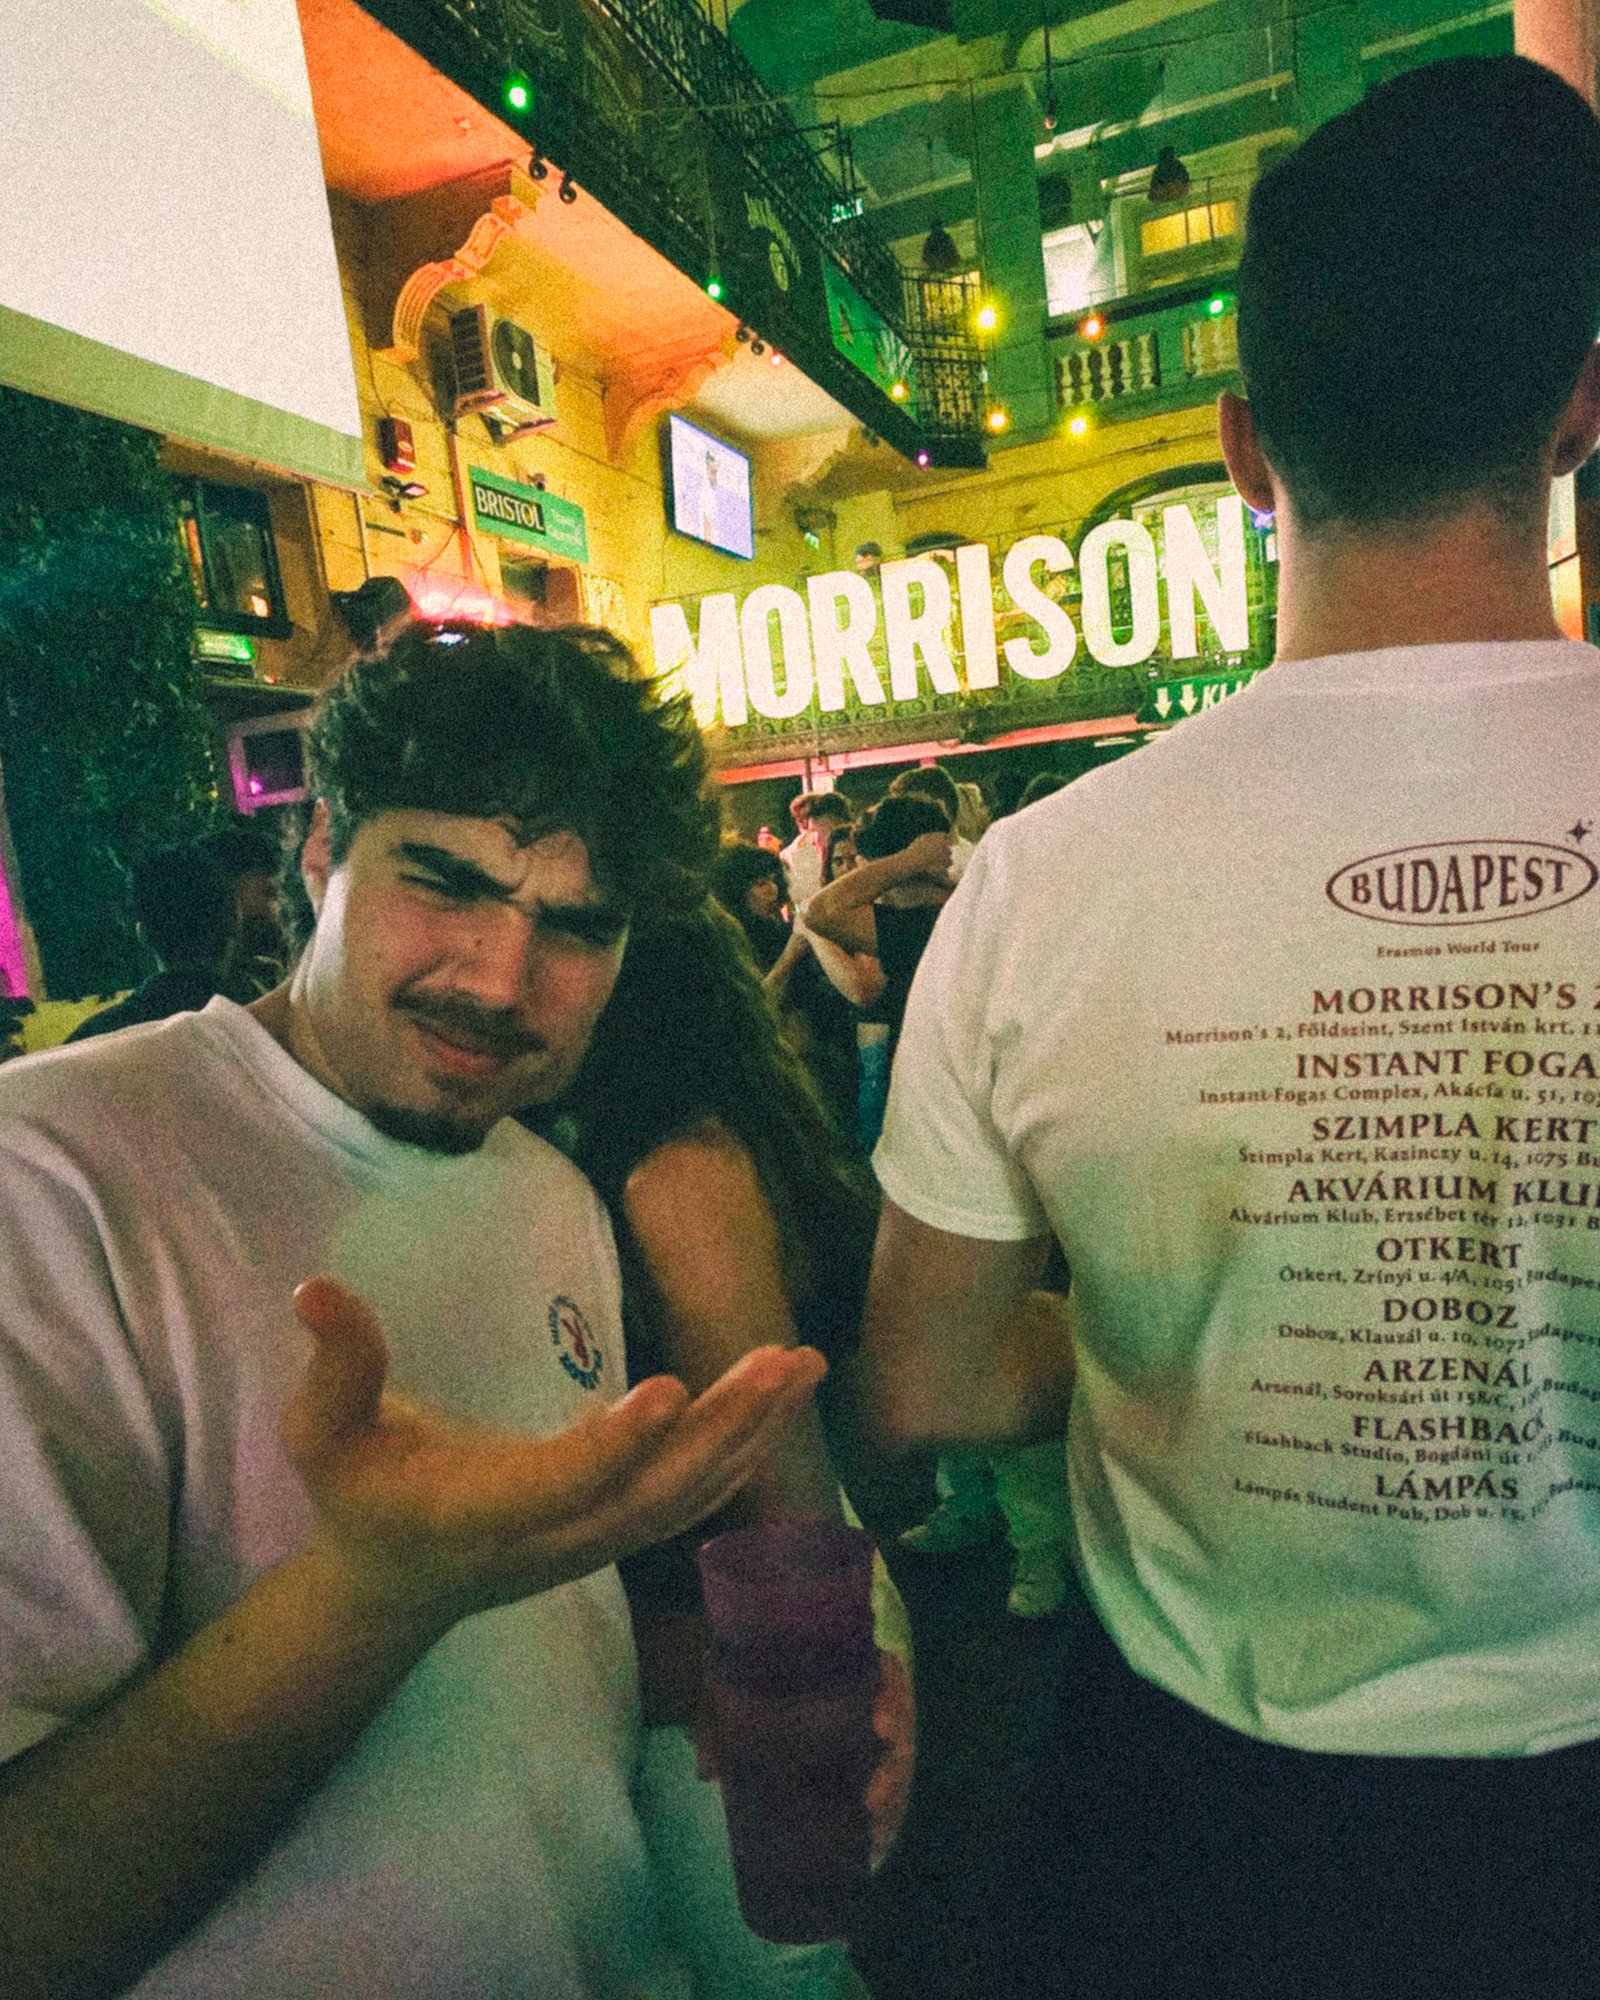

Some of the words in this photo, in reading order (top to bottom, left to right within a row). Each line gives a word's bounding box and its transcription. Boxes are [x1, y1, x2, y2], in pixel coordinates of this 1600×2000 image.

[475, 486, 545, 531] BRISTOL
[650, 496, 1249, 728] MORRISON
[1351, 854, 1572, 914] BUDAPEST
[1377, 946, 1441, 958] Erasmus
[1447, 940, 1495, 956] World
[1501, 940, 1540, 954] Tour
[1312, 982, 1577, 1014] MORRISON'S
[1166, 1026, 1268, 1045] Morrison's
[1400, 1019, 1454, 1035] Szent
[1462, 1018, 1525, 1034] István
[1535, 1018, 1575, 1036] krt.
[1296, 1049, 1469, 1080] INSTANT
[1484, 1050, 1600, 1080] FOGA
[1334, 1084, 1428, 1105] Complex,
[1511, 1089, 1530, 1101] u.
[1313, 1111, 1481, 1141] SZIMPLA
[1495, 1115, 1598, 1144] KERT
[1239, 1147, 1314, 1167] Szimpla
[1321, 1148, 1368, 1164] Kert,
[1288, 1170, 1497, 1205] AKVÁRIUM
[1327, 1208, 1379, 1225] Klub,
[1376, 1237, 1522, 1269] OTKERT
[1383, 1298, 1518, 1329] DOBOZ
[1364, 1358, 1532, 1388] ARZENÁL
[1376, 1469, 1519, 1500] LÁMPÁS
